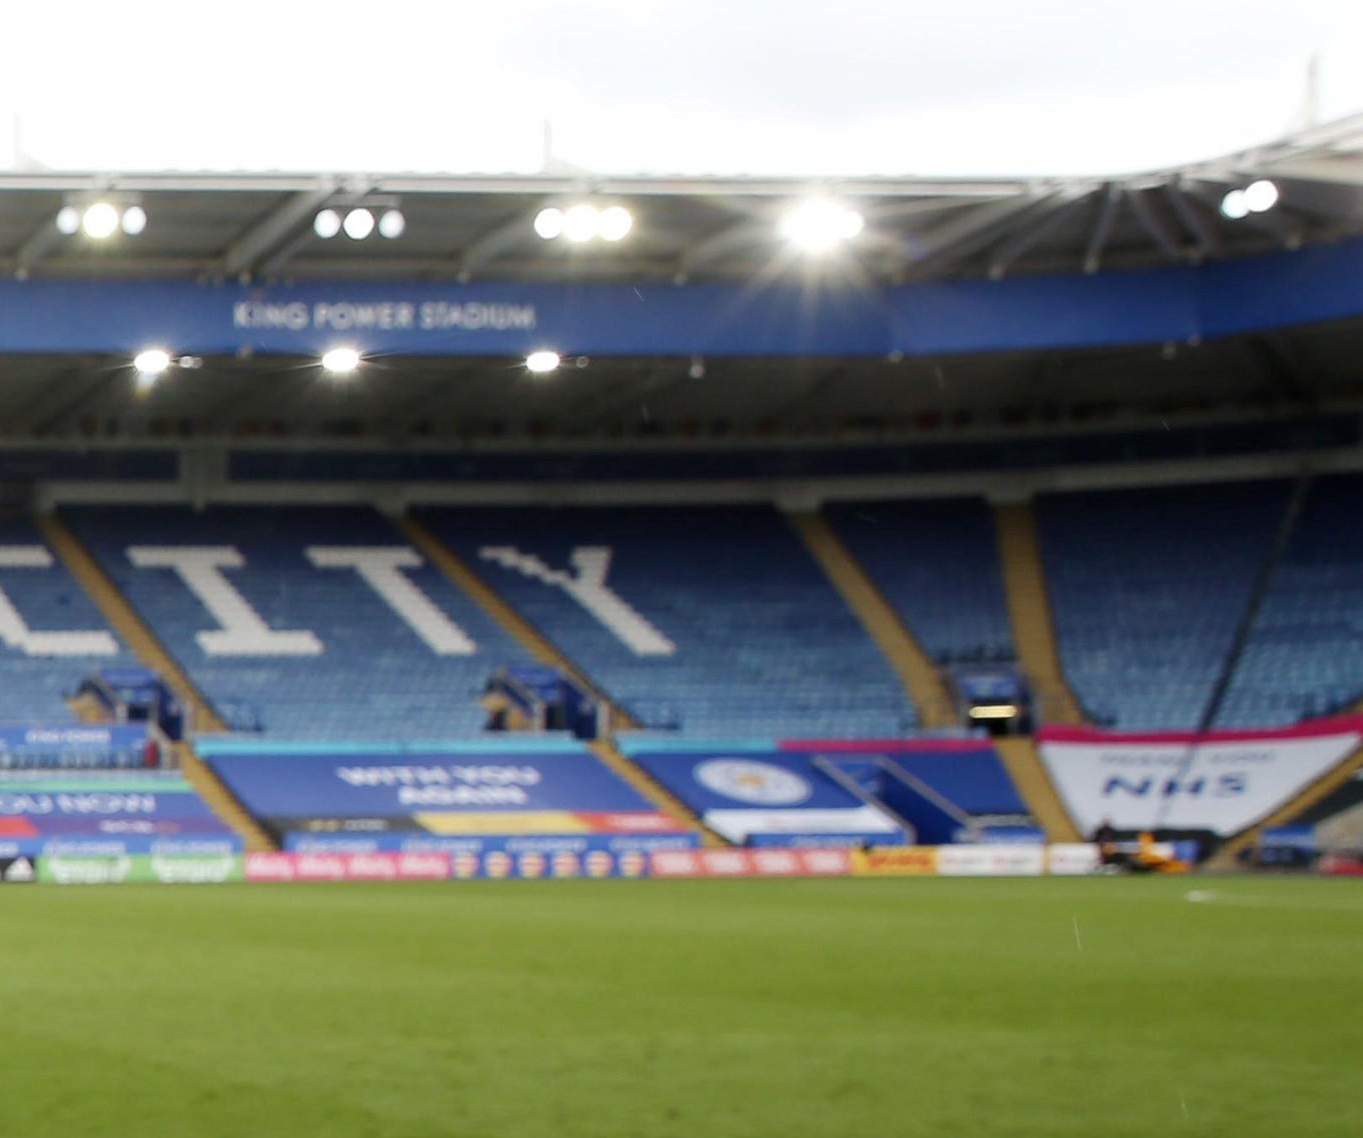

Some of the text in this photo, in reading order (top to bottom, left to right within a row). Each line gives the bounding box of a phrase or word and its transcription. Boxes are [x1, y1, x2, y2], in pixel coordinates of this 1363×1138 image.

[233, 301, 536, 330] KING POWER STADIUM
[336, 765, 542, 786] WITH YOU
[1102, 773, 1247, 798] NHS
